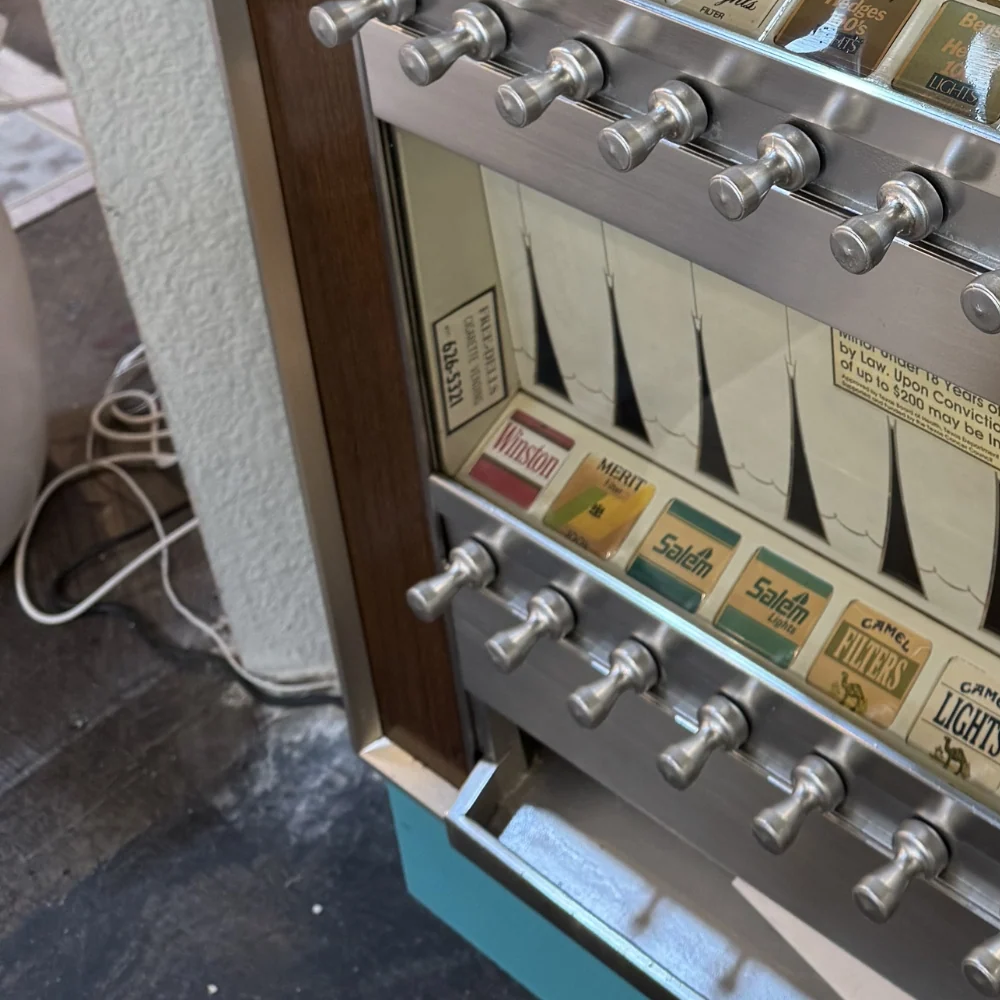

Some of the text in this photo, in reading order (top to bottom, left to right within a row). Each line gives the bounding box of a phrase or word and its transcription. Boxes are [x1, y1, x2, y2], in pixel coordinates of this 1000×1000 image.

[700, 6, 726, 20] FILTER
[928, 75, 978, 102] LIGHTS
[442, 340, 464, 409] 626-5321
[840, 341, 856, 359] by
[860, 350, 890, 376] Law.
[894, 368, 929, 398] Upon
[840, 360, 853, 372] of
[856, 366, 873, 382] up
[876, 376, 890, 392] to
[894, 384, 925, 411] $200
[928, 404, 960, 430] may
[965, 422, 984, 440] be
[492, 422, 560, 480] Winston
[597, 457, 647, 492] MERIT
[652, 532, 714, 580] Salem
[745, 576, 810, 626] Salem
[768, 612, 796, 636] Lights
[861, 617, 910, 653] CAMEL
[832, 630, 909, 692] FILTERS
